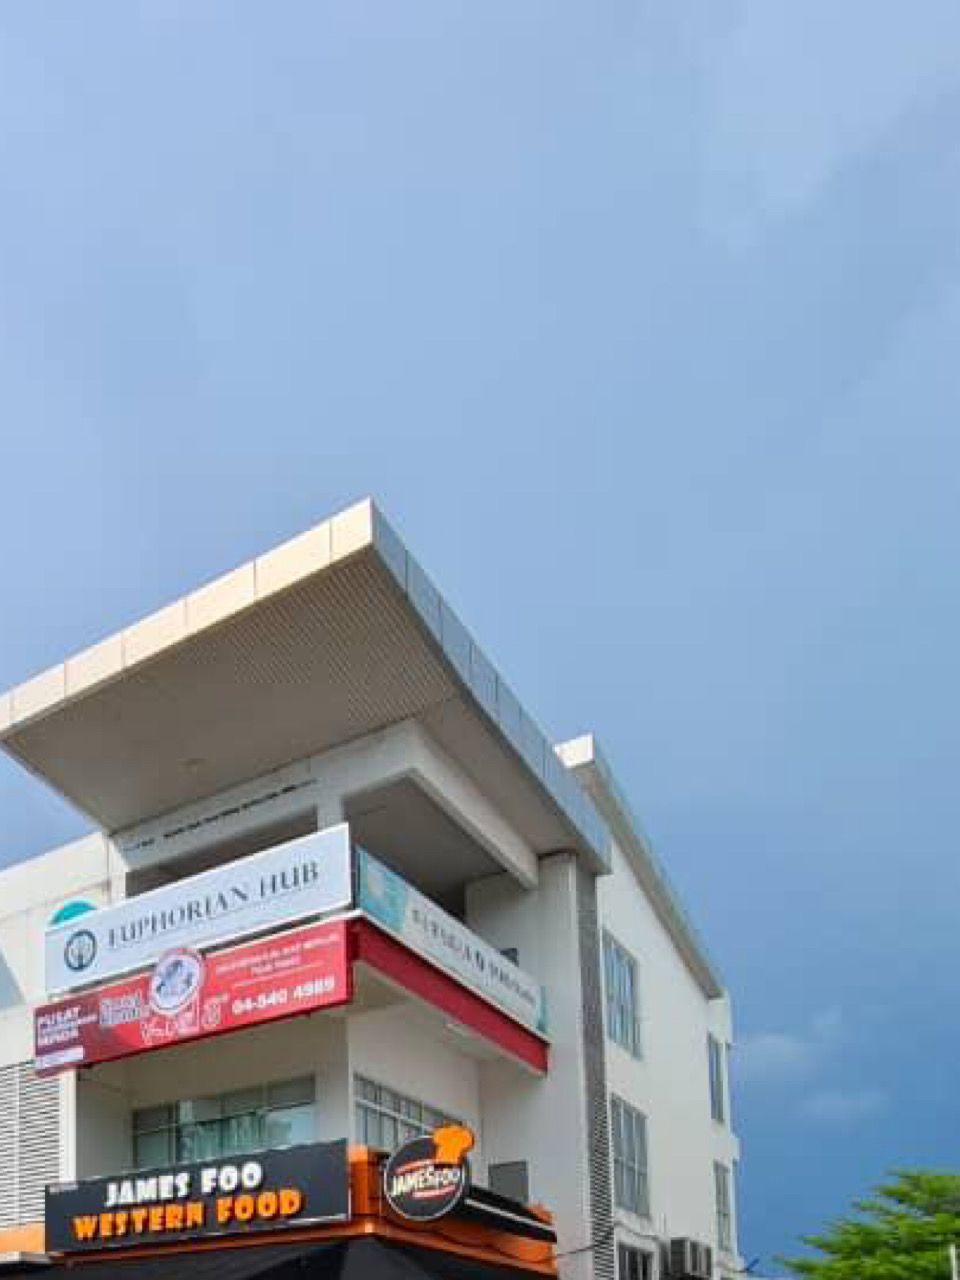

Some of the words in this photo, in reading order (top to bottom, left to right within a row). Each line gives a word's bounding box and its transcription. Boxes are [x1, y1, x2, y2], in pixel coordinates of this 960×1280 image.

[108, 885, 249, 948] EUPHORIAN
[259, 860, 319, 899] HUB
[104, 1171, 190, 1208] JAMES
[200, 1160, 265, 1195] FOO
[72, 1201, 206, 1241] WESTERN
[215, 1187, 305, 1224] FOOD
